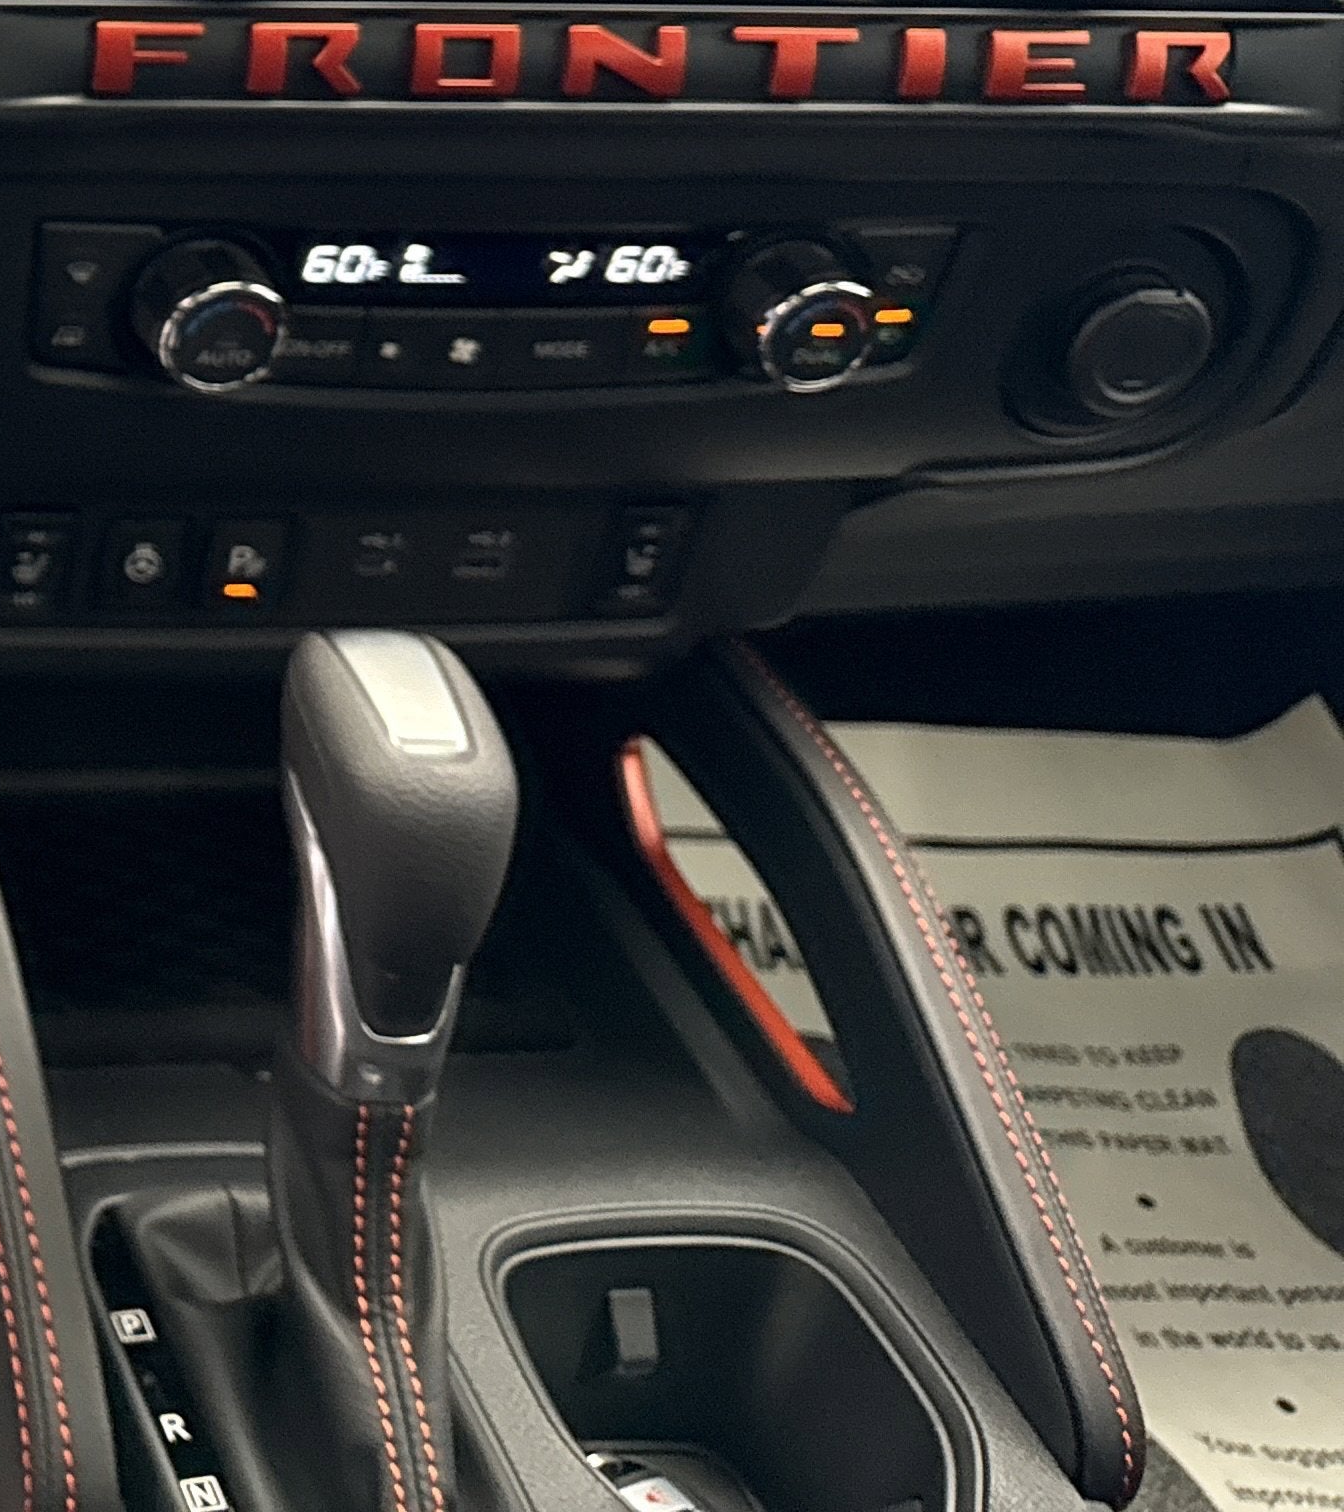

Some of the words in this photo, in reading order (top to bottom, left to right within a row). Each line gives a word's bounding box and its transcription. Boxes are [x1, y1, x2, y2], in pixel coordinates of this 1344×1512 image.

[91, 20, 1232, 100] FRONTIER
[1004, 902, 1202, 977] COMING
[1201, 901, 1276, 973] IN
[159, 1412, 193, 1444] R
